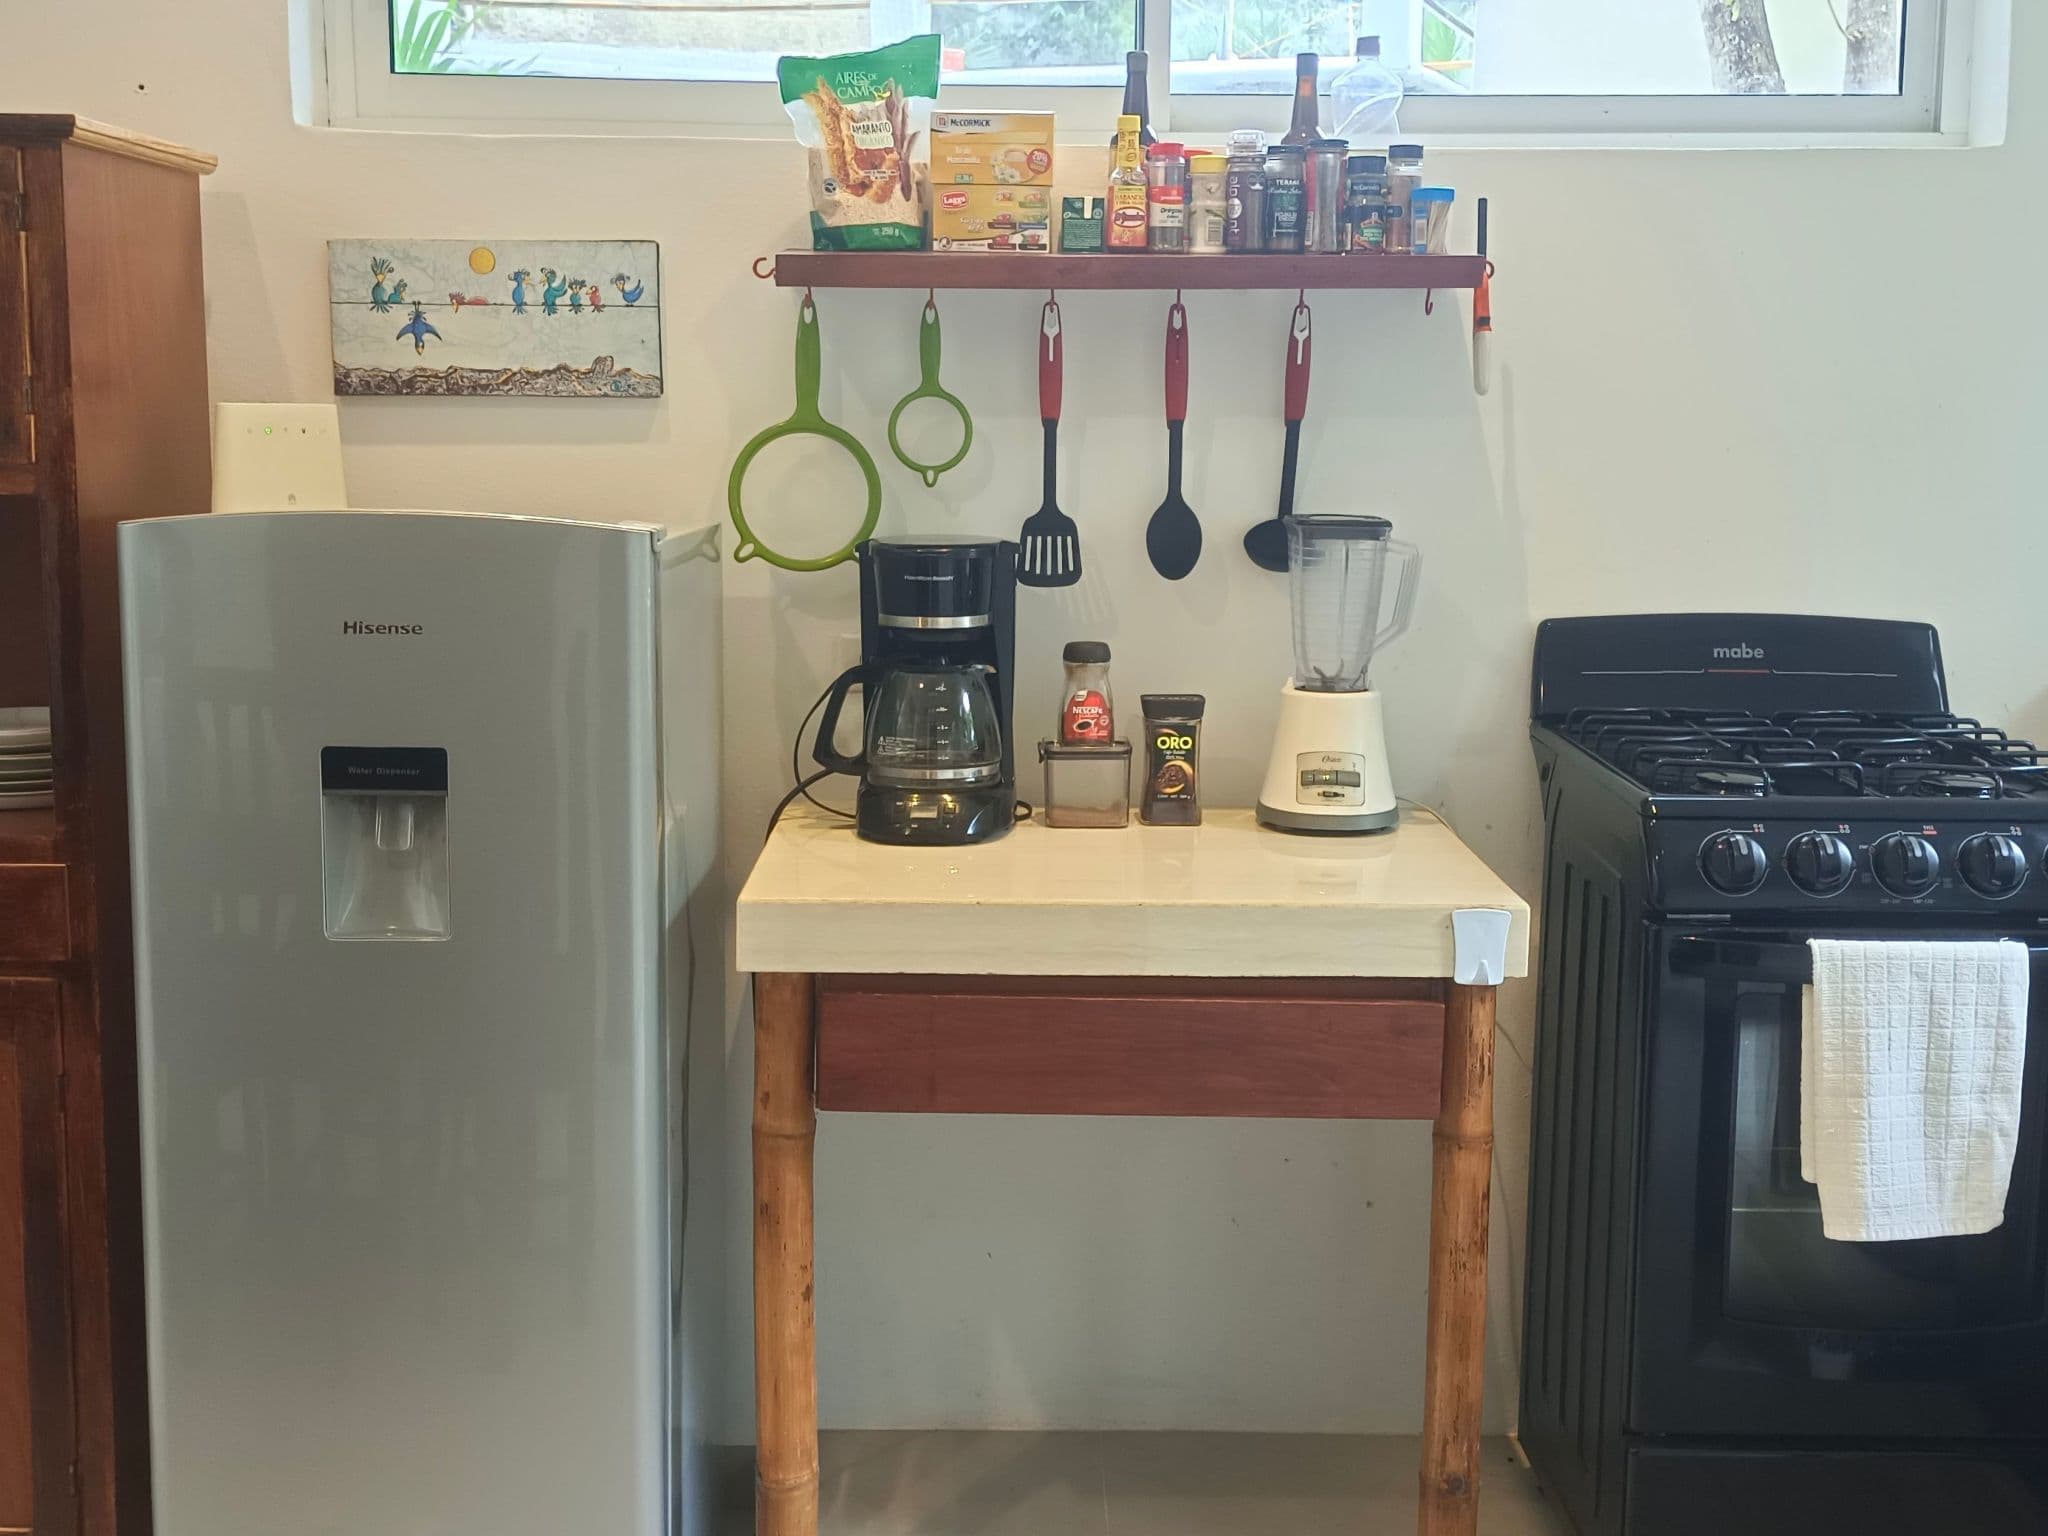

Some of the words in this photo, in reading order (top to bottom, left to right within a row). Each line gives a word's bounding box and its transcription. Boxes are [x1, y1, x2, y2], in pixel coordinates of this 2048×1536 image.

[835, 71, 866, 86] AIRES
[837, 85, 883, 99] CAMPO
[851, 121, 892, 135] AMARANTO
[950, 118, 992, 127] McCORMICK
[343, 621, 424, 635] Hisense
[1713, 642, 1764, 658] mabe
[1157, 736, 1193, 750] ORO
[348, 767, 373, 775] Water
[376, 767, 421, 776] Dispenser
